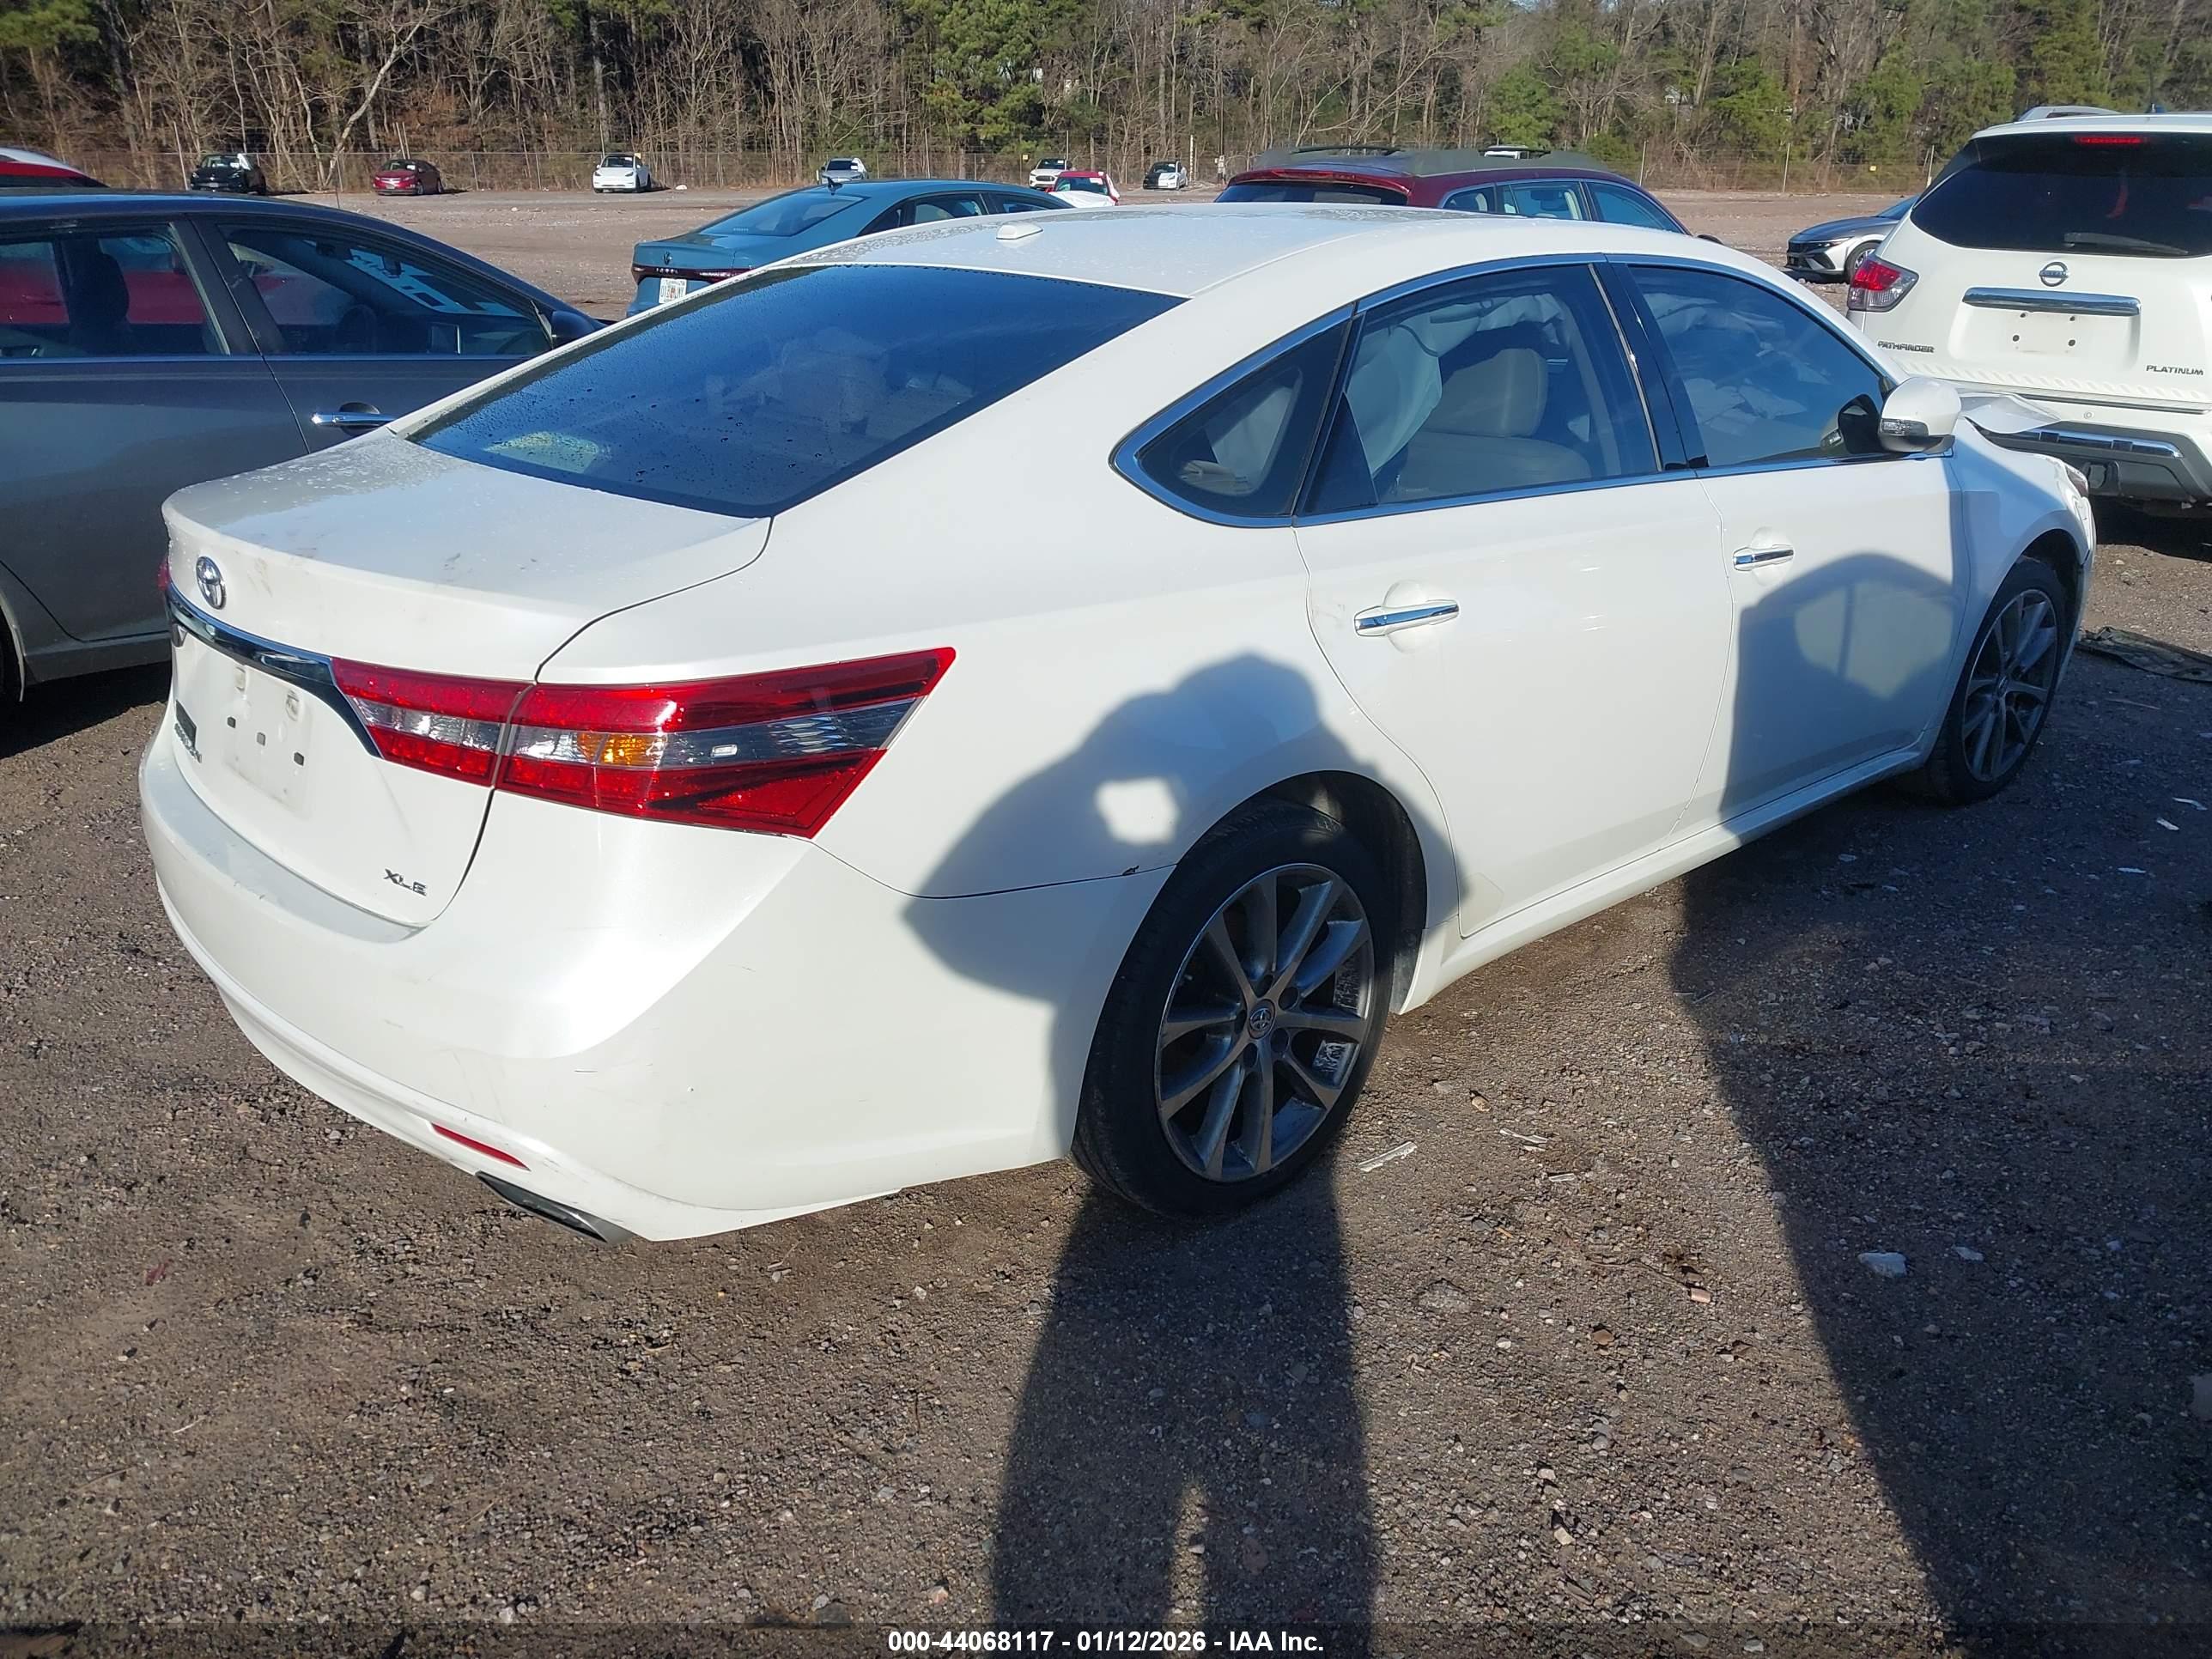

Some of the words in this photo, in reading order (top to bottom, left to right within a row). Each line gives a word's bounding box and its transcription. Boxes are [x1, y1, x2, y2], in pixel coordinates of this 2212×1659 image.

[1877, 340, 1935, 354] PATHFINDER
[2146, 364, 2203, 376] PLATINUM
[383, 867, 427, 897] XLE
